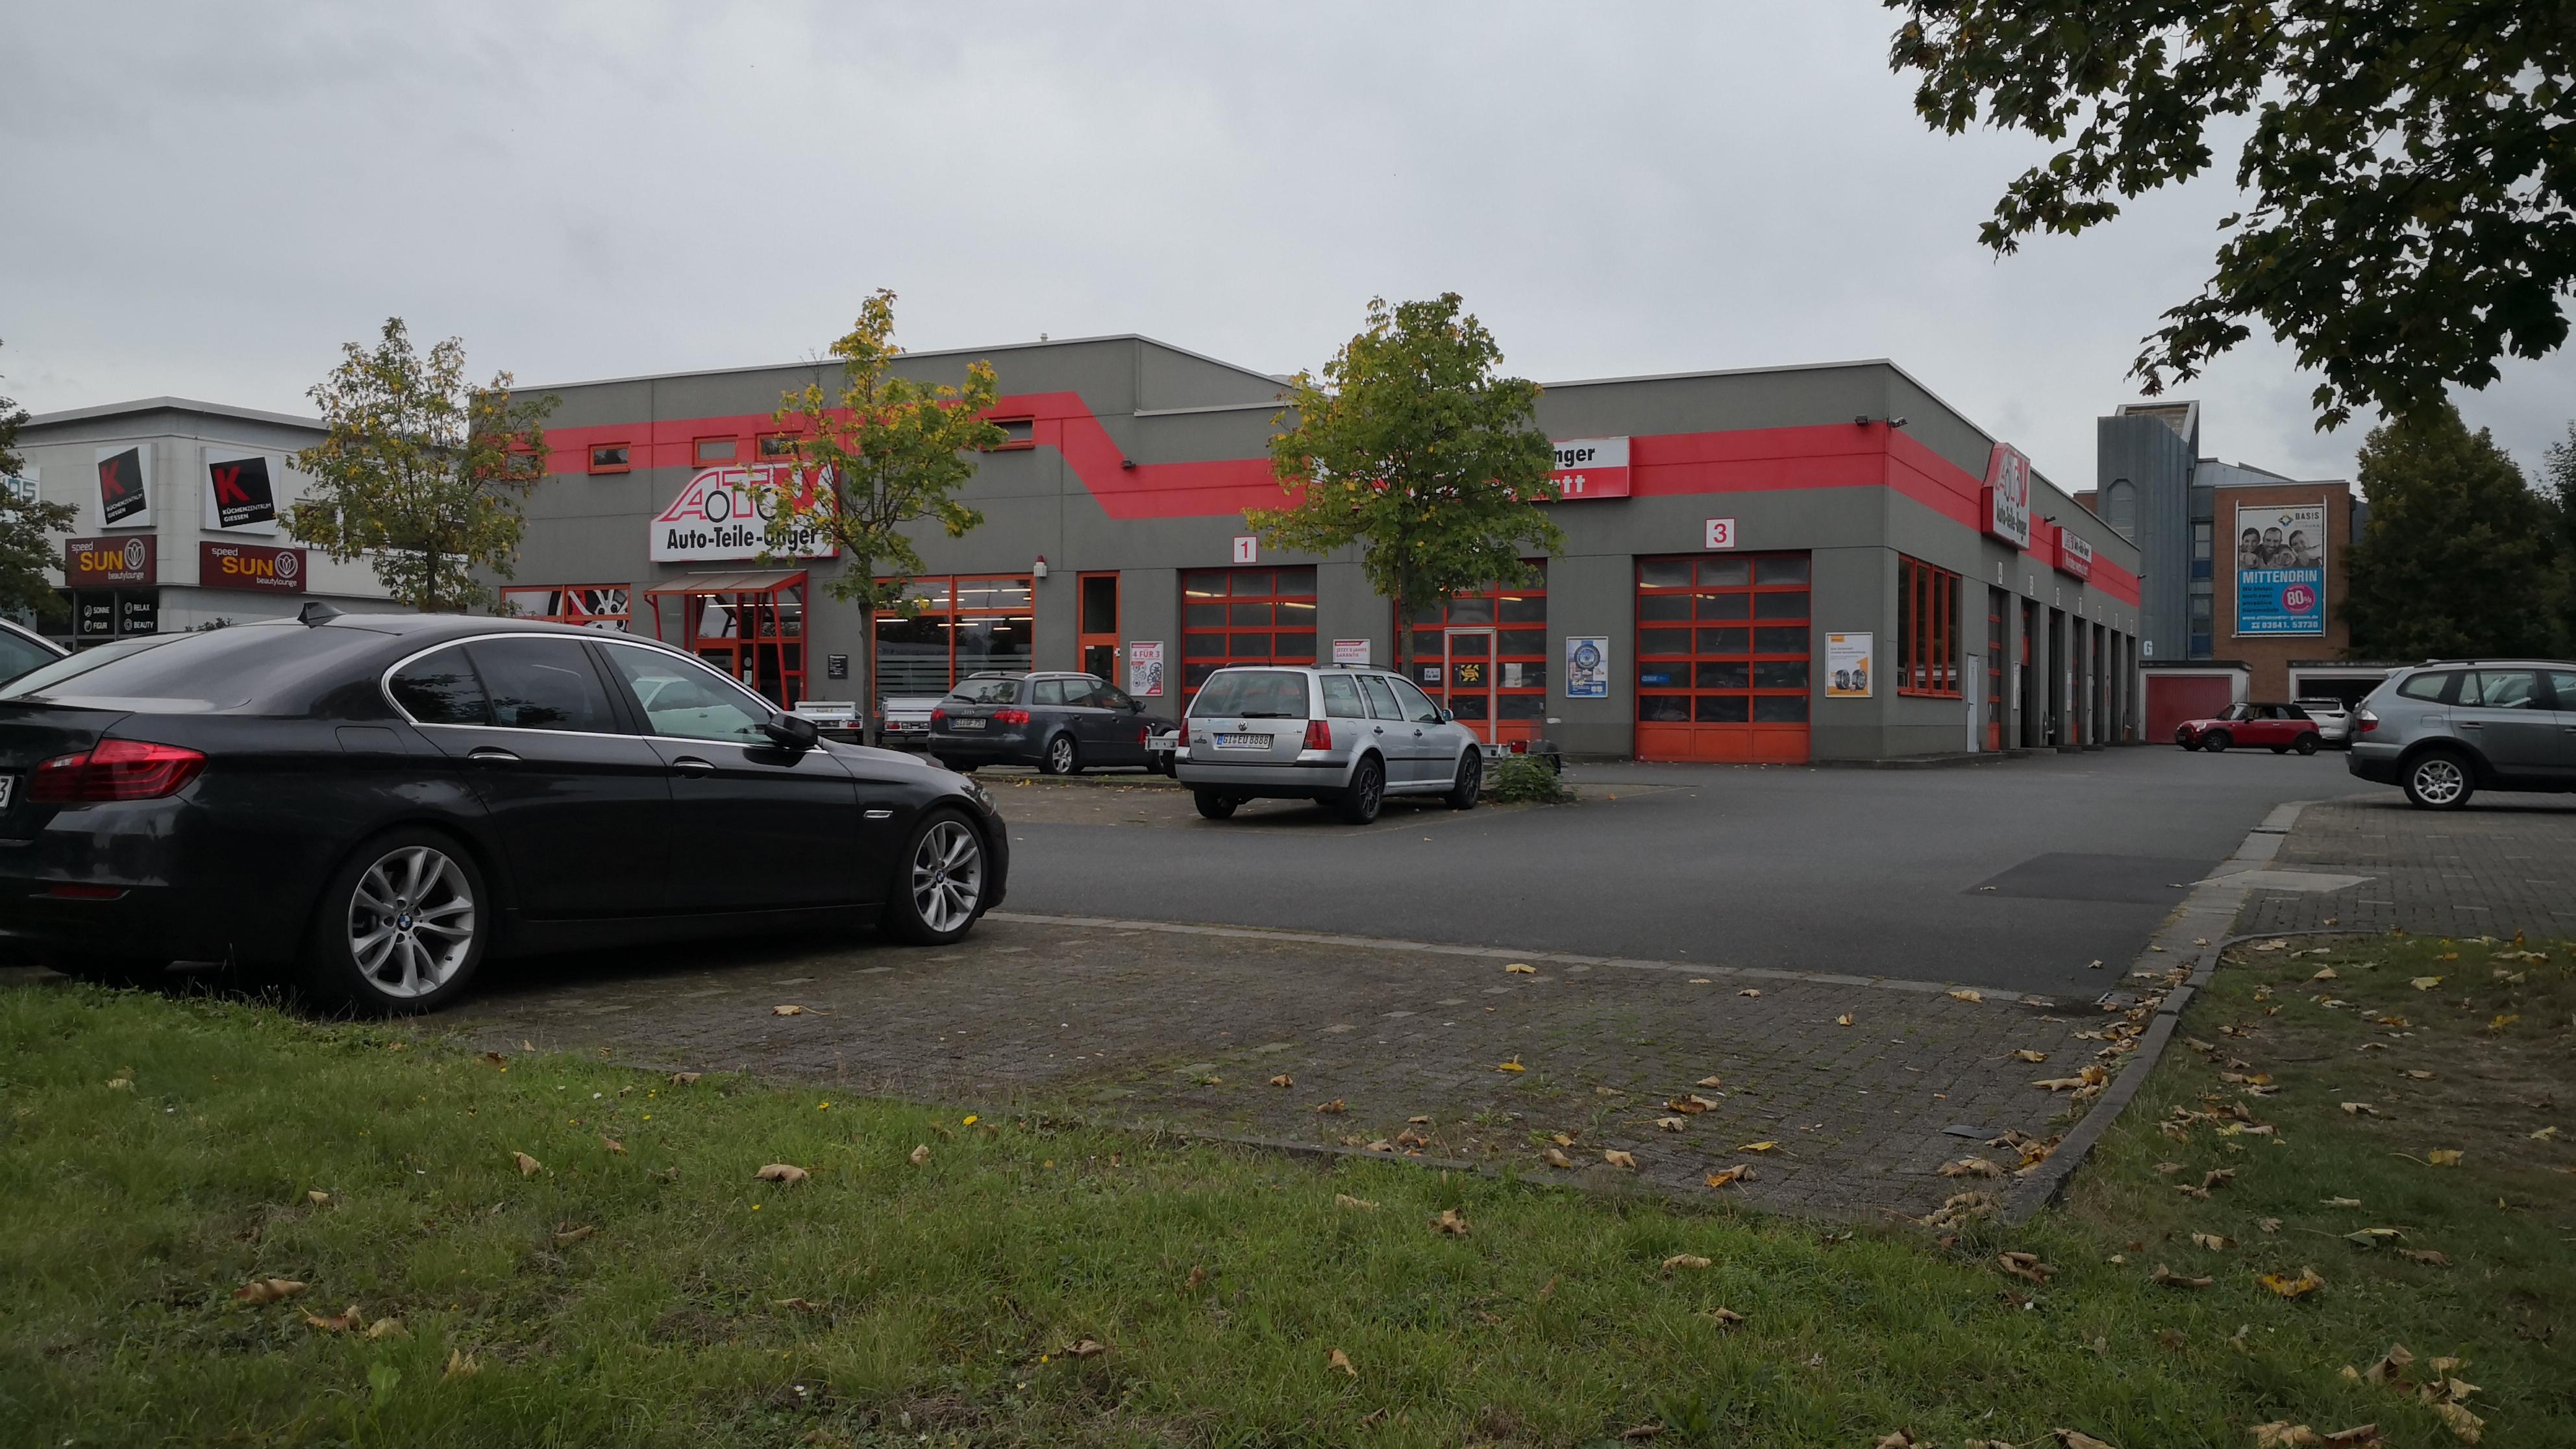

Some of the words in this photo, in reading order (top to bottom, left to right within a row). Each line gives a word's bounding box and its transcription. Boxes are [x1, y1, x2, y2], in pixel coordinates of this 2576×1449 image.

[101, 460, 125, 500] K
[216, 466, 250, 505] K
[223, 503, 271, 515] KÜCHENZENTRUM
[224, 514, 249, 522] GIESSEN
[1714, 523, 1727, 543] 3
[71, 541, 93, 553] speed
[211, 547, 238, 557] speed
[1241, 540, 1248, 558] 1
[80, 551, 123, 571] SUN
[221, 556, 273, 576] SUN
[256, 576, 297, 588] beautylounge
[2287, 589, 2312, 606] 80%
[1139, 649, 1154, 658] FÜR
[2144, 640, 2153, 656] G
[1223, 734, 1232, 743] GI
[1237, 734, 1248, 743] EU
